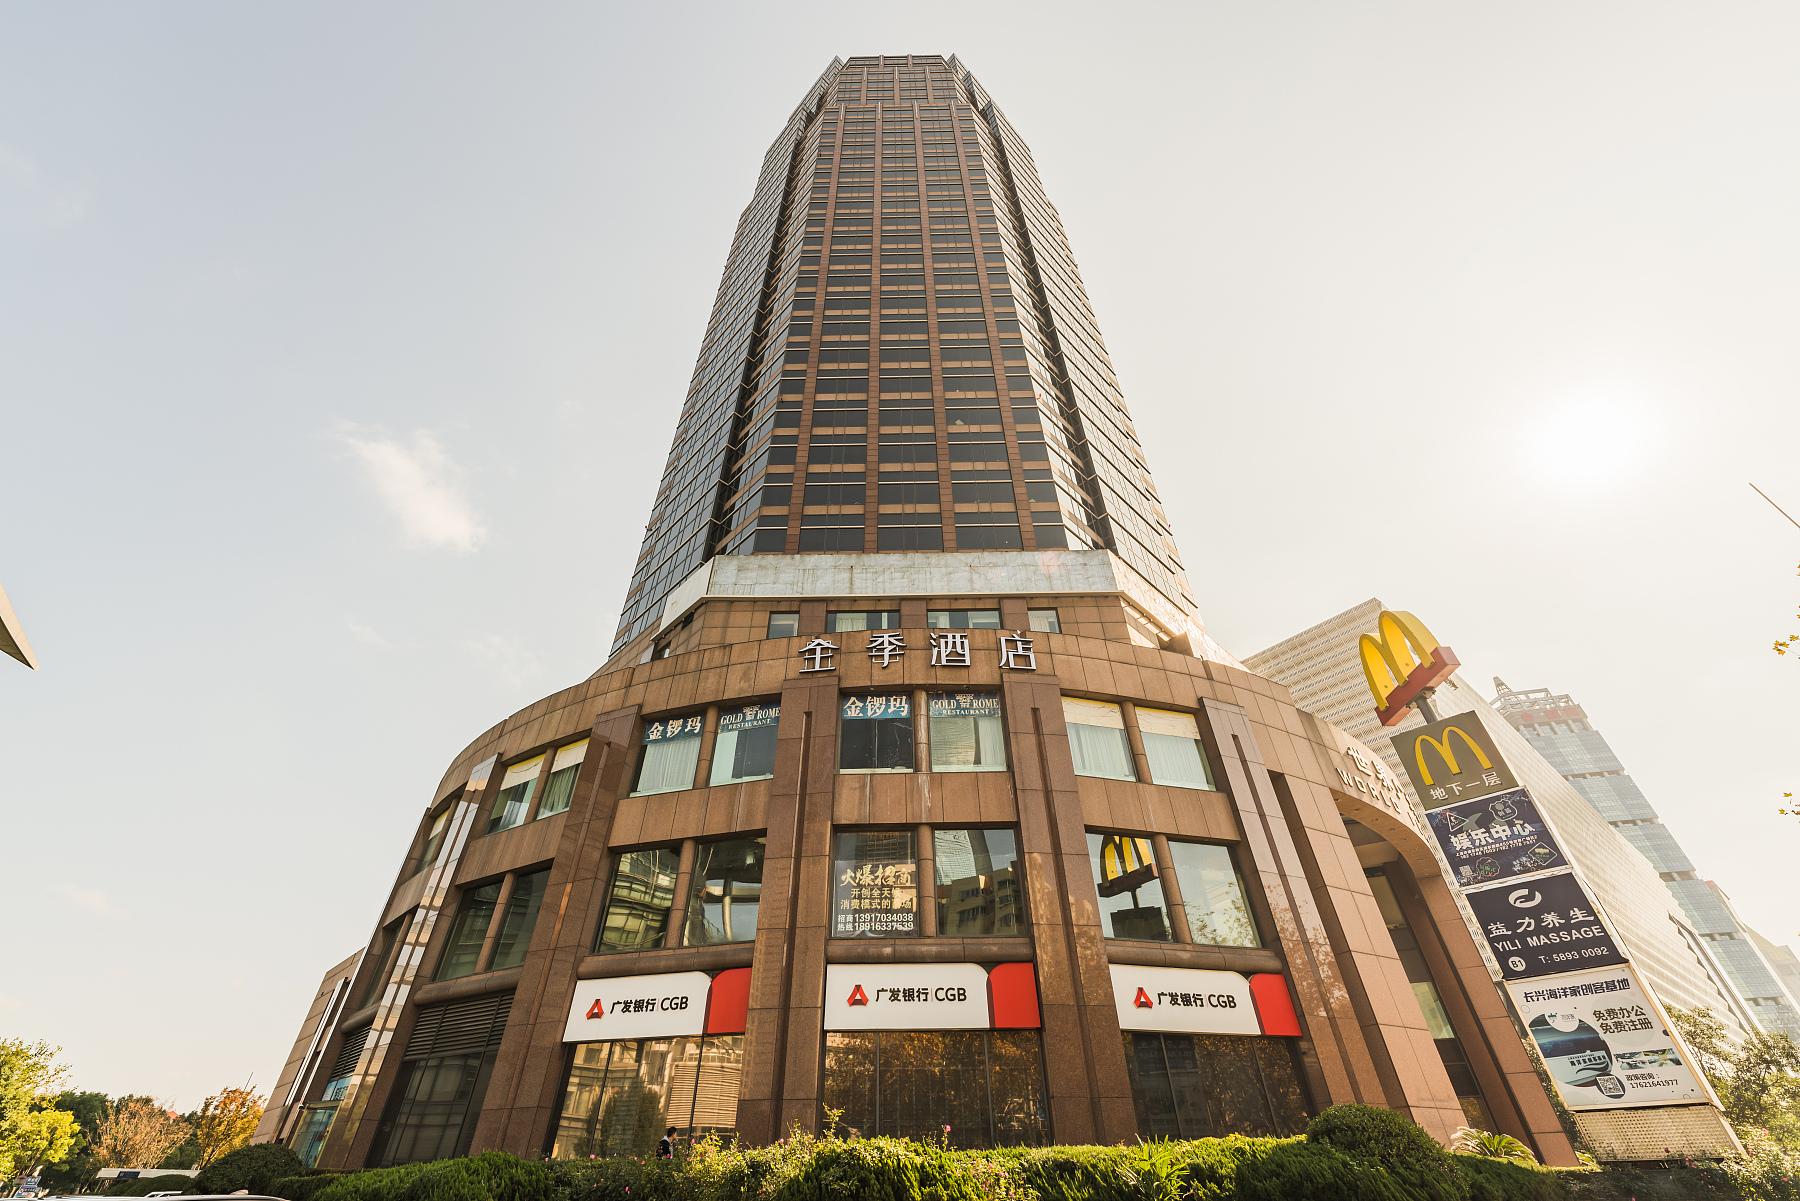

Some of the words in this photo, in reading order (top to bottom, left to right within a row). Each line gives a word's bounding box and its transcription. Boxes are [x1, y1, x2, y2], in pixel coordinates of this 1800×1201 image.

[799, 630, 1036, 673] 全季酒店
[843, 695, 908, 717] 金锣玛
[932, 699, 956, 710] GOLD
[973, 698, 999, 709] ROME
[721, 713, 743, 725] GOLD
[728, 718, 771, 730] RESTAURANT
[648, 716, 702, 741] 金锣玛
[1429, 771, 1501, 801] 地下一层
[1449, 819, 1536, 851] 娱乐中心
[855, 913, 914, 922] 13917034038
[1488, 907, 1594, 938] 益力养生
[1493, 938, 1522, 953] YILI
[1527, 925, 1605, 948] MASSAGE
[1511, 959, 1524, 969] B1
[1538, 955, 1551, 965] T:
[1552, 951, 1580, 962] 5893
[1582, 946, 1609, 958] 0092
[875, 987, 929, 1003] 广发银行
[934, 987, 967, 1002] CGB
[1157, 991, 1205, 1008] 广发银行
[1208, 993, 1237, 1009] CGB
[609, 998, 656, 1015] 广发银行
[660, 996, 689, 1012] CGB
[1592, 1005, 1647, 1022] 免费办公
[1599, 1017, 1654, 1035] 免费注册
